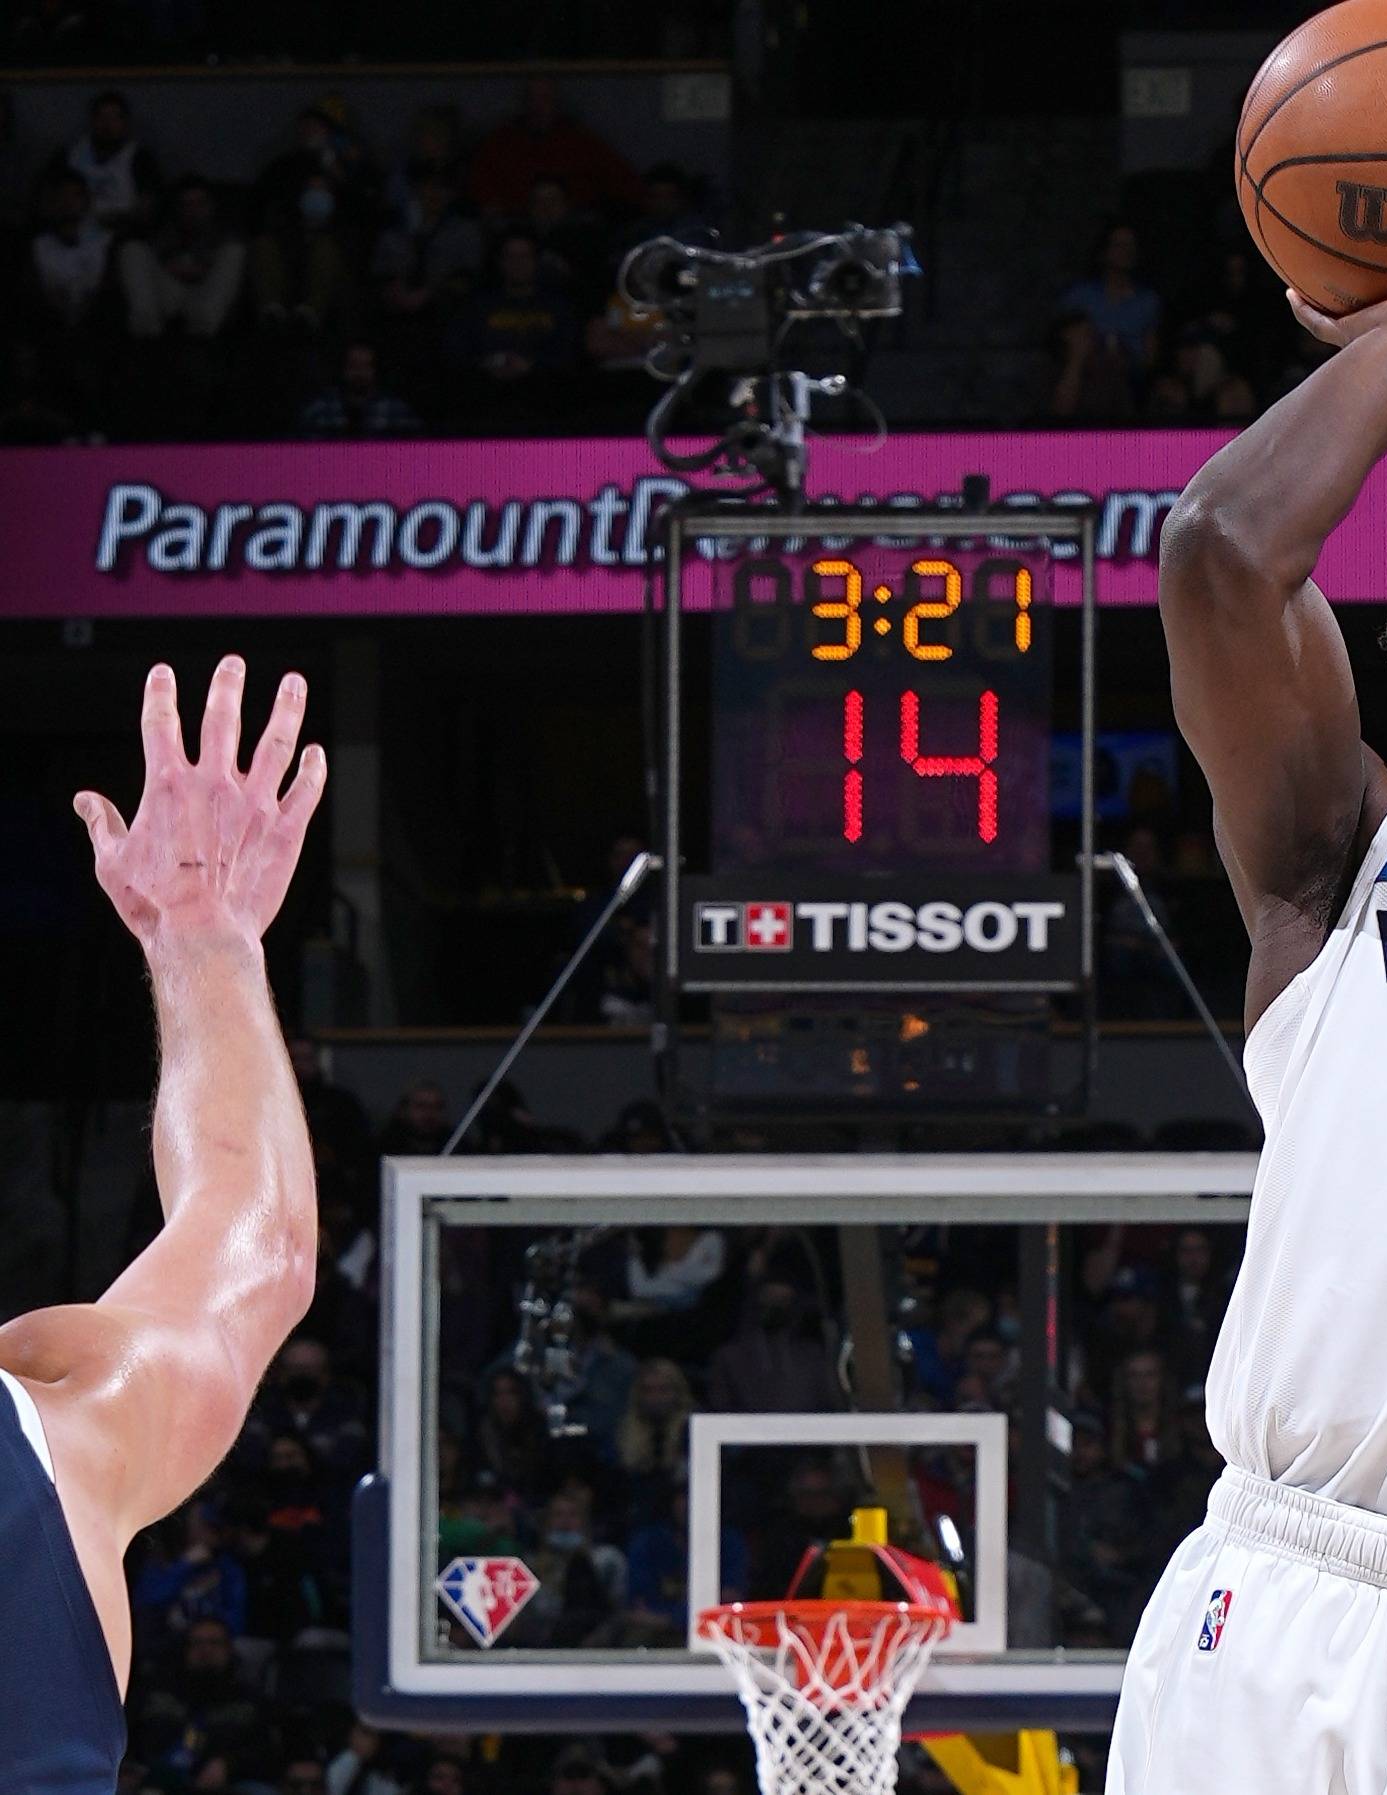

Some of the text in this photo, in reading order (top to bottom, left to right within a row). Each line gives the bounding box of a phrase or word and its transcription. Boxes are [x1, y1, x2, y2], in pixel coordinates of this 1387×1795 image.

[811, 560, 1032, 661] 3:21
[844, 690, 999, 844] 14
[796, 901, 1065, 952] TISSOT
